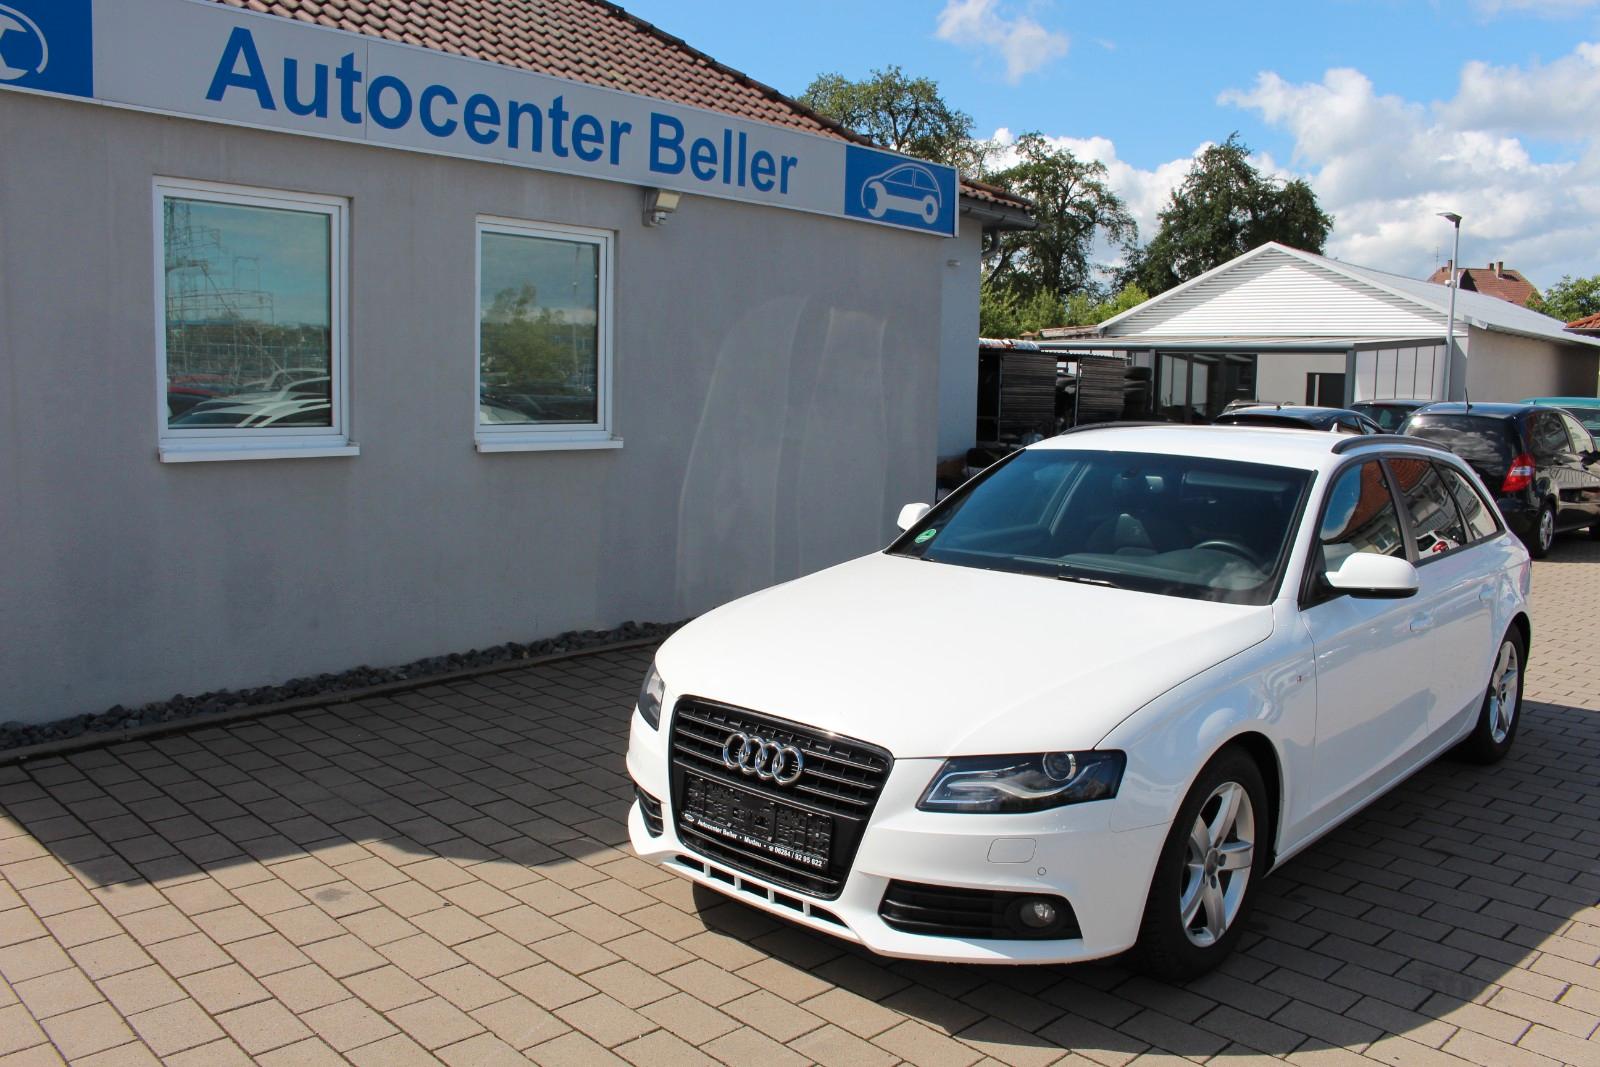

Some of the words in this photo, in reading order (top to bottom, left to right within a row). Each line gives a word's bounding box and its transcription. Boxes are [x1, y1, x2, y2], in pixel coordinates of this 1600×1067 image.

[205, 26, 632, 167] Autocenter
[649, 111, 798, 195] Beller
[743, 835, 762, 848] Mudau
[774, 846, 791, 857] 06284
